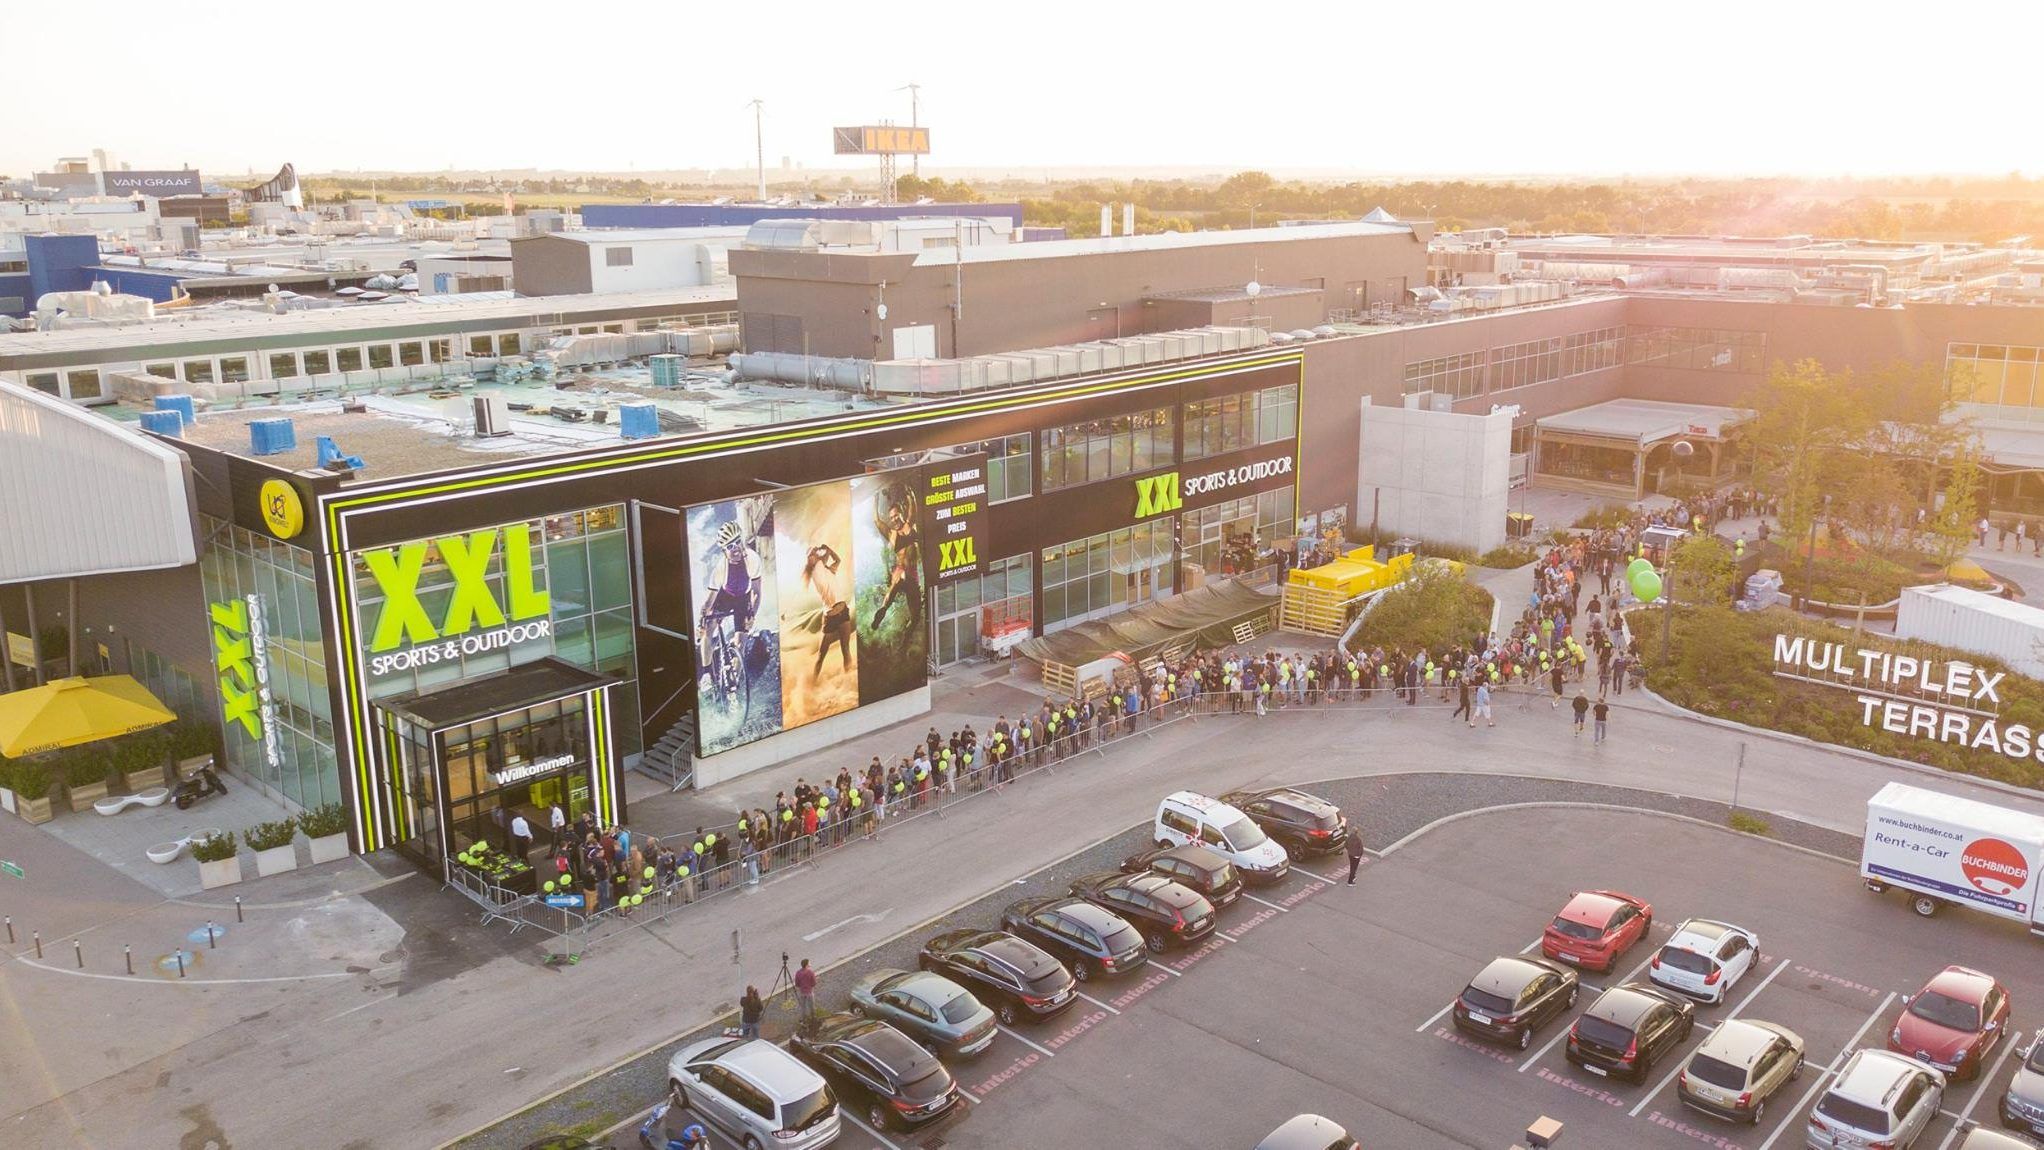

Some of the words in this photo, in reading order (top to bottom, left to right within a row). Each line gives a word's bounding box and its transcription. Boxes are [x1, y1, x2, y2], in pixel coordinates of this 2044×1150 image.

[866, 127, 928, 152] IKEA
[112, 178, 141, 187] VAN
[144, 178, 193, 187] GRAAF
[930, 474, 951, 488] BESTE
[952, 468, 980, 483] MARKEN
[1134, 472, 1183, 518] XXL
[1185, 472, 1226, 497] SPORTS
[1227, 469, 1237, 486] &
[1238, 456, 1292, 484] OUTDOOR
[925, 490, 954, 506] GRÖSSTE
[955, 484, 986, 499] AUSWAHL
[936, 507, 952, 520] ZUM
[952, 502, 977, 517] BESTEN
[947, 521, 967, 534] PREIS
[939, 536, 977, 571] XXL
[362, 523, 550, 653] XXL
[372, 645, 440, 677] SPORTS
[443, 639, 460, 661] &
[461, 619, 551, 655] OUTDOOR
[210, 599, 263, 740] XXL
[1773, 634, 2006, 703] MULTIPLEX
[495, 754, 575, 784] Willkommen
[1878, 815, 1964, 842] www.buchbinder.co.at
[1875, 832, 1950, 859] Rent-a-Car
[1961, 855, 2028, 880] BUCHBINDER
[1226, 908, 1278, 938] interio
[1170, 939, 1226, 971] interio
[1109, 972, 1169, 1009] interio
[1043, 1011, 1107, 1050] interio
[970, 1052, 1040, 1095] interio
[1537, 1067, 1624, 1107] interio
